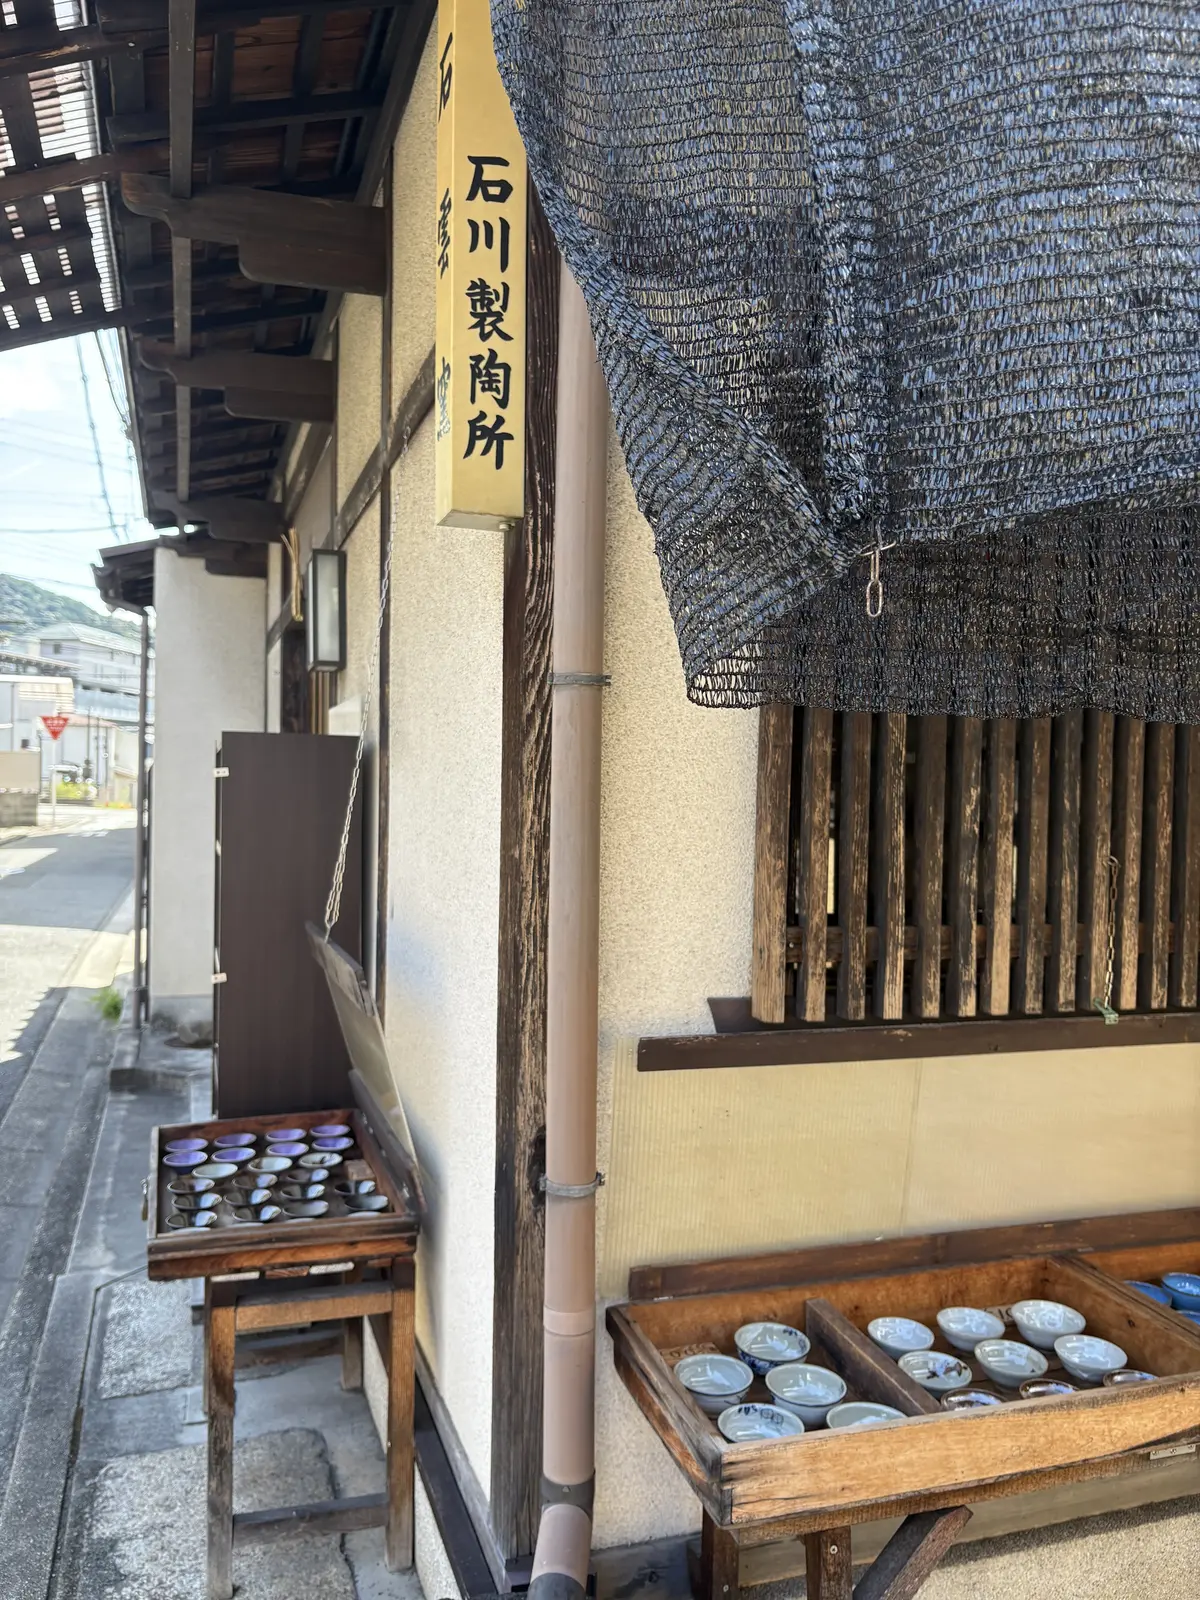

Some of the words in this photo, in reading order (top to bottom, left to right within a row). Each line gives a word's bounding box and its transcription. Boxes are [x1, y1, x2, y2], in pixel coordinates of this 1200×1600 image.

[463, 155, 514, 470] 石川製陶所
